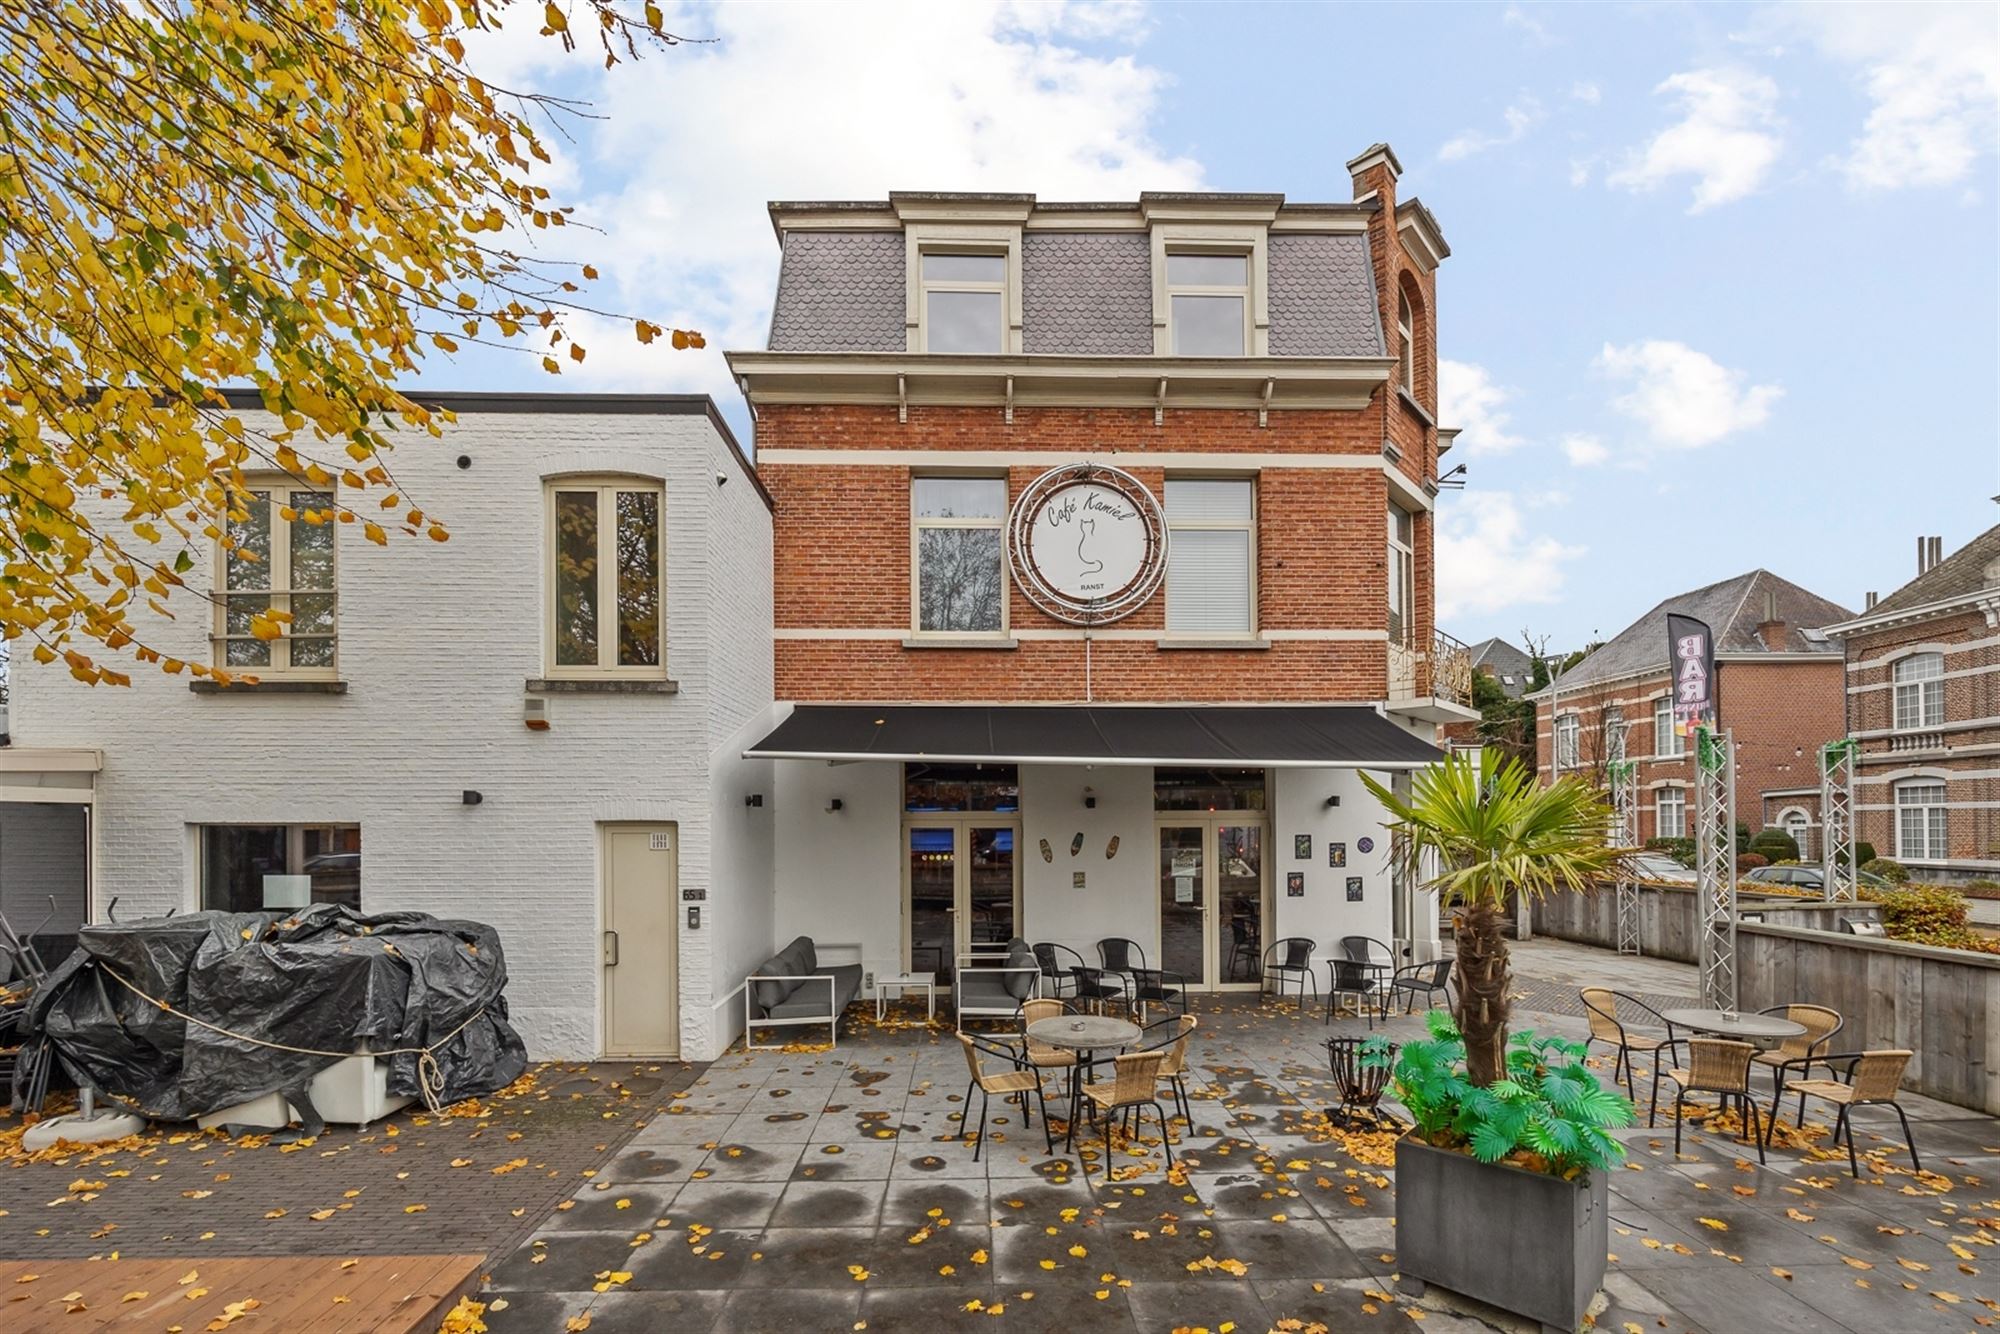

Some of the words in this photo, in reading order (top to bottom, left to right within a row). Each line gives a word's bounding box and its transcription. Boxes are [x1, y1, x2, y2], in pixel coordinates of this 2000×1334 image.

[1048, 497, 1077, 527] Café
[1083, 492, 1136, 520] Kamiel
[1080, 583, 1104, 591] RANST
